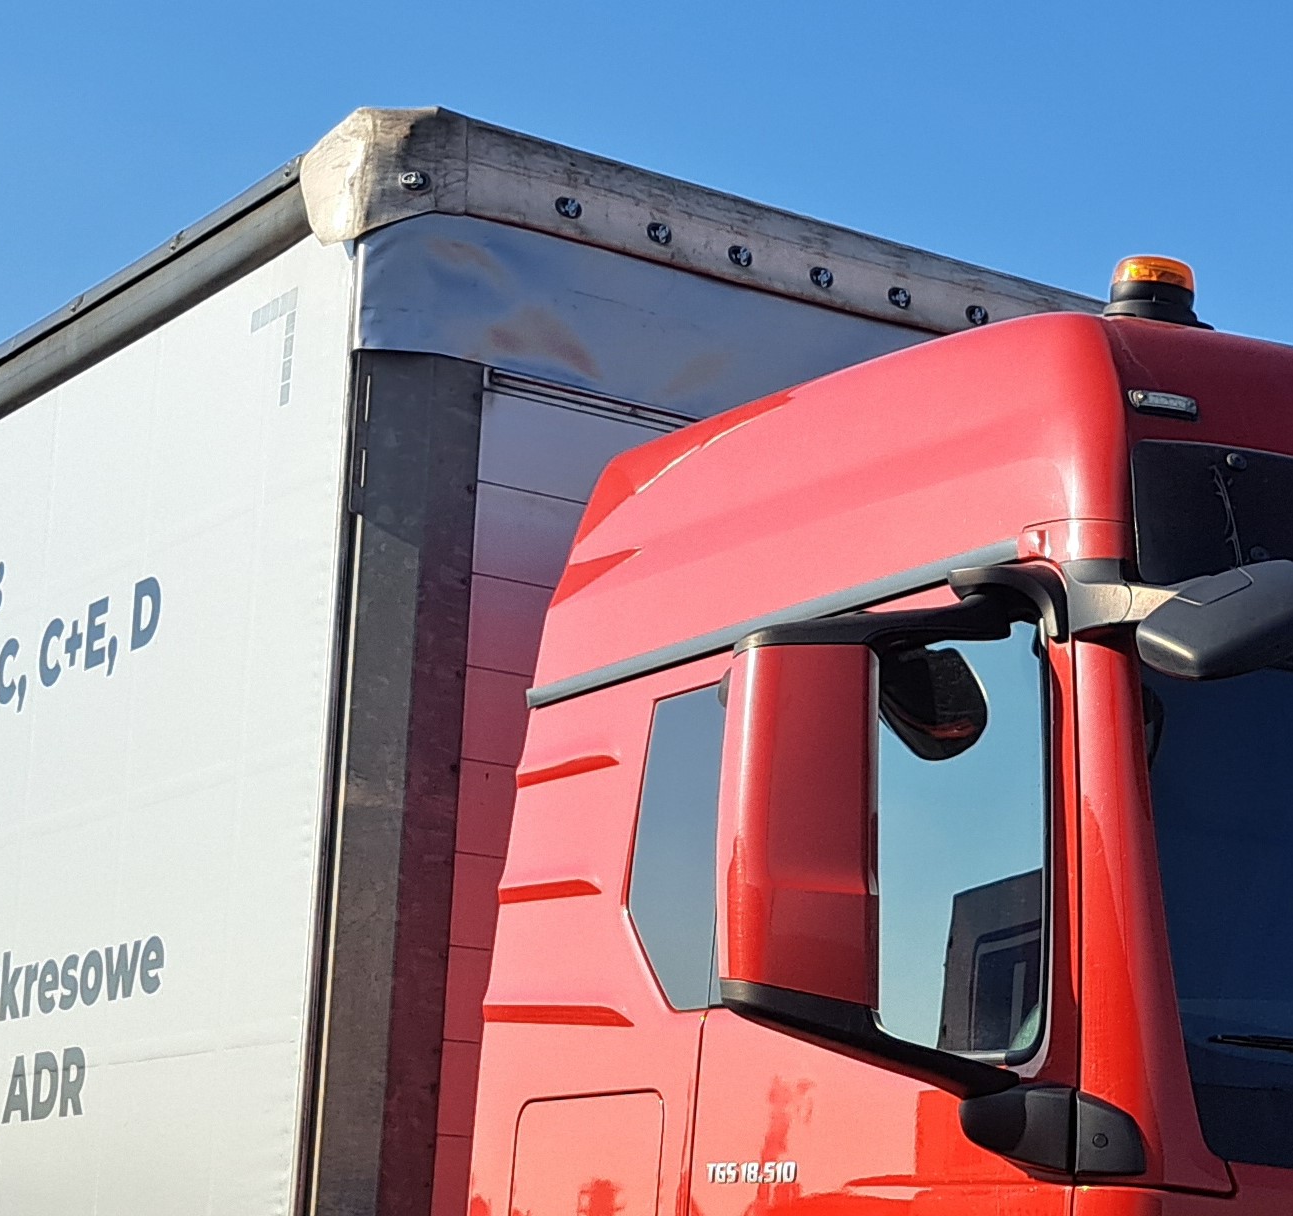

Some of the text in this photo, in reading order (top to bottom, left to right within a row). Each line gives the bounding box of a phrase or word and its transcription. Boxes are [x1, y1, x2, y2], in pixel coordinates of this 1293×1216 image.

[39, 596, 118, 688] C+E,
[131, 577, 161, 651] D
[1, 1046, 86, 1124] ADR
[706, 1161, 797, 1184] TGS 18.510
